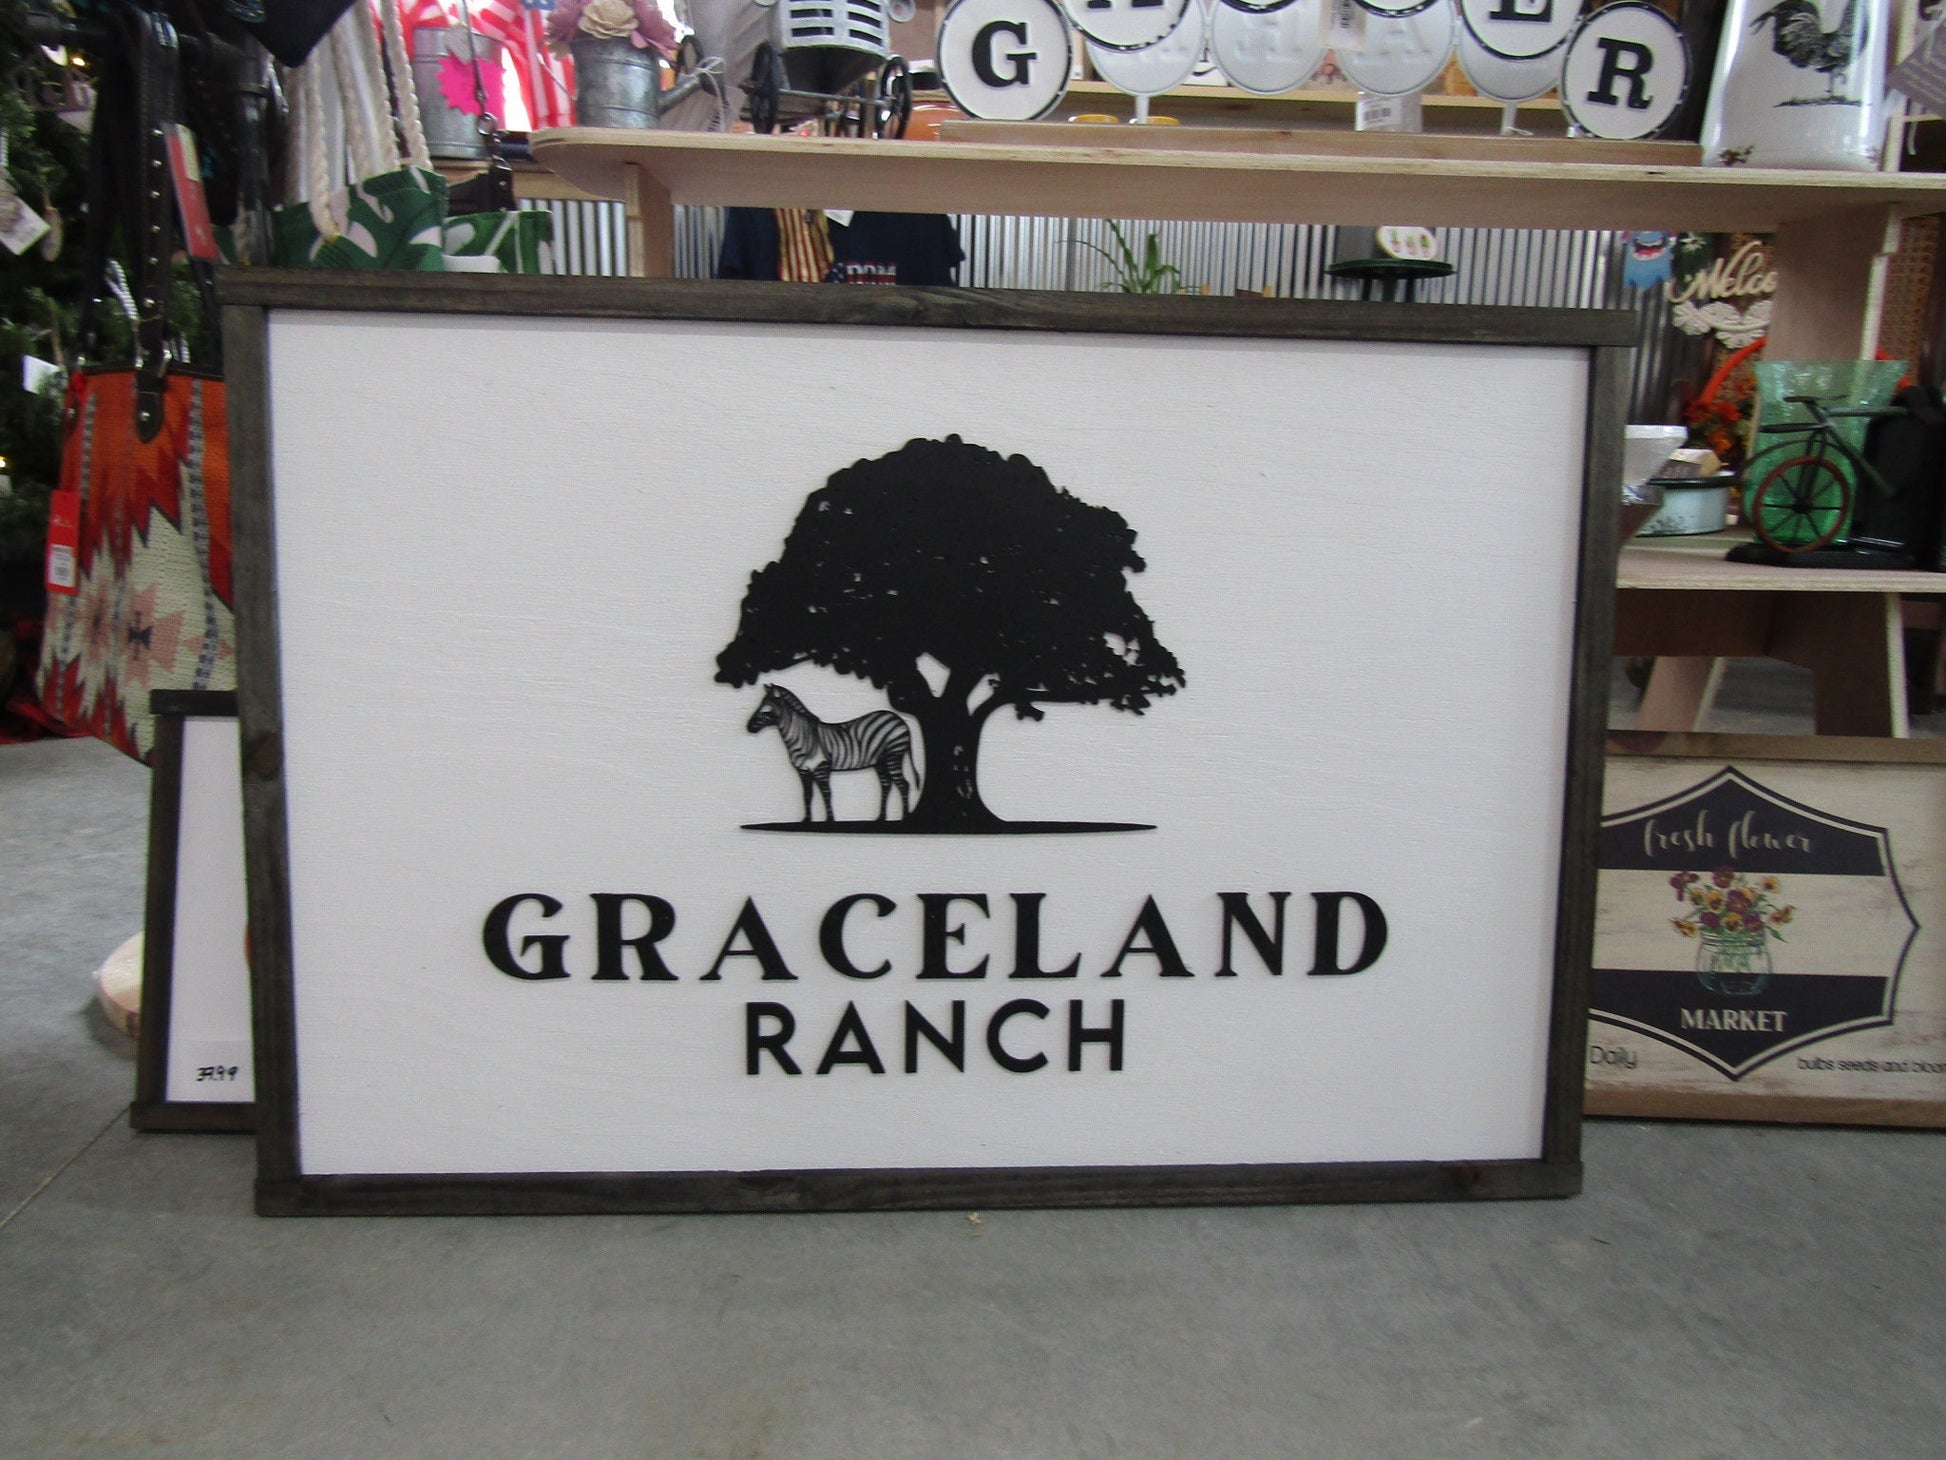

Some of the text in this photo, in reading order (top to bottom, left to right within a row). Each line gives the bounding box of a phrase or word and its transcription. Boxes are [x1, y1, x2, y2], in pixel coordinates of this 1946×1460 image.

[971, 20, 1037, 87] G
[1586, 37, 1654, 110] R
[1643, 809, 1811, 860] fresh flower
[482, 891, 1388, 981] GRACELAND
[745, 998, 1125, 1076] RANCH
[1679, 1006, 1789, 1032] MARKET
[1589, 1045, 1638, 1069] Daily
